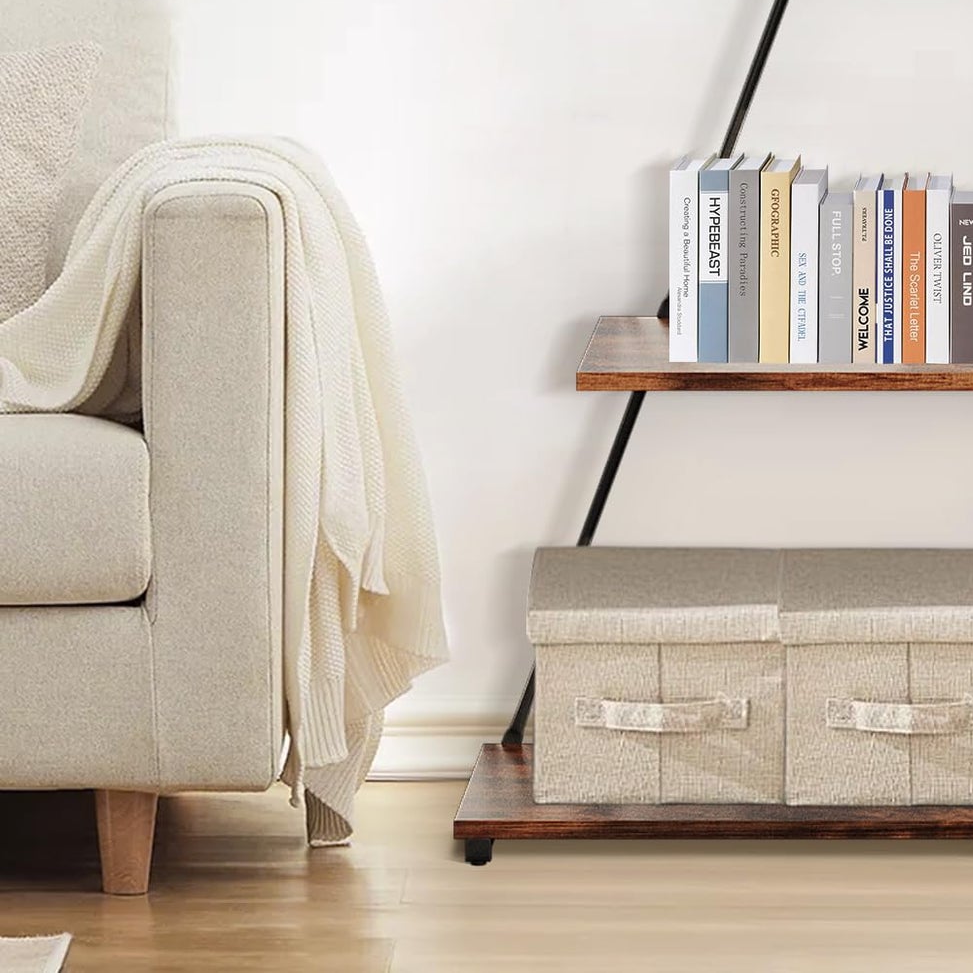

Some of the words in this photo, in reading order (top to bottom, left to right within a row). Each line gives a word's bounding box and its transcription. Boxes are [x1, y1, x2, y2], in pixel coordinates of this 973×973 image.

[682, 197, 692, 230] Creating
[738, 182, 748, 248] Constructing
[832, 211, 842, 238] FULL
[884, 208, 894, 228] DONE
[708, 198, 720, 276] HYPEBEAST
[884, 234, 894, 244] BE
[933, 233, 942, 270] OLIVER
[962, 236, 972, 266] JED
[682, 238, 692, 273] Beautiful
[798, 252, 806, 267] SEX
[884, 246, 894, 274] SHALL
[910, 252, 920, 272] The
[682, 274, 690, 298] Home
[798, 271, 806, 286] AND
[910, 274, 920, 310] Scarlet
[933, 271, 942, 304] TWIST
[962, 272, 972, 306] LIND
[798, 290, 806, 304] THE
[884, 277, 894, 315] JUSTICE
[858, 288, 869, 351] WELCOME
[884, 318, 894, 342] THAT
[910, 313, 920, 342] Letter
